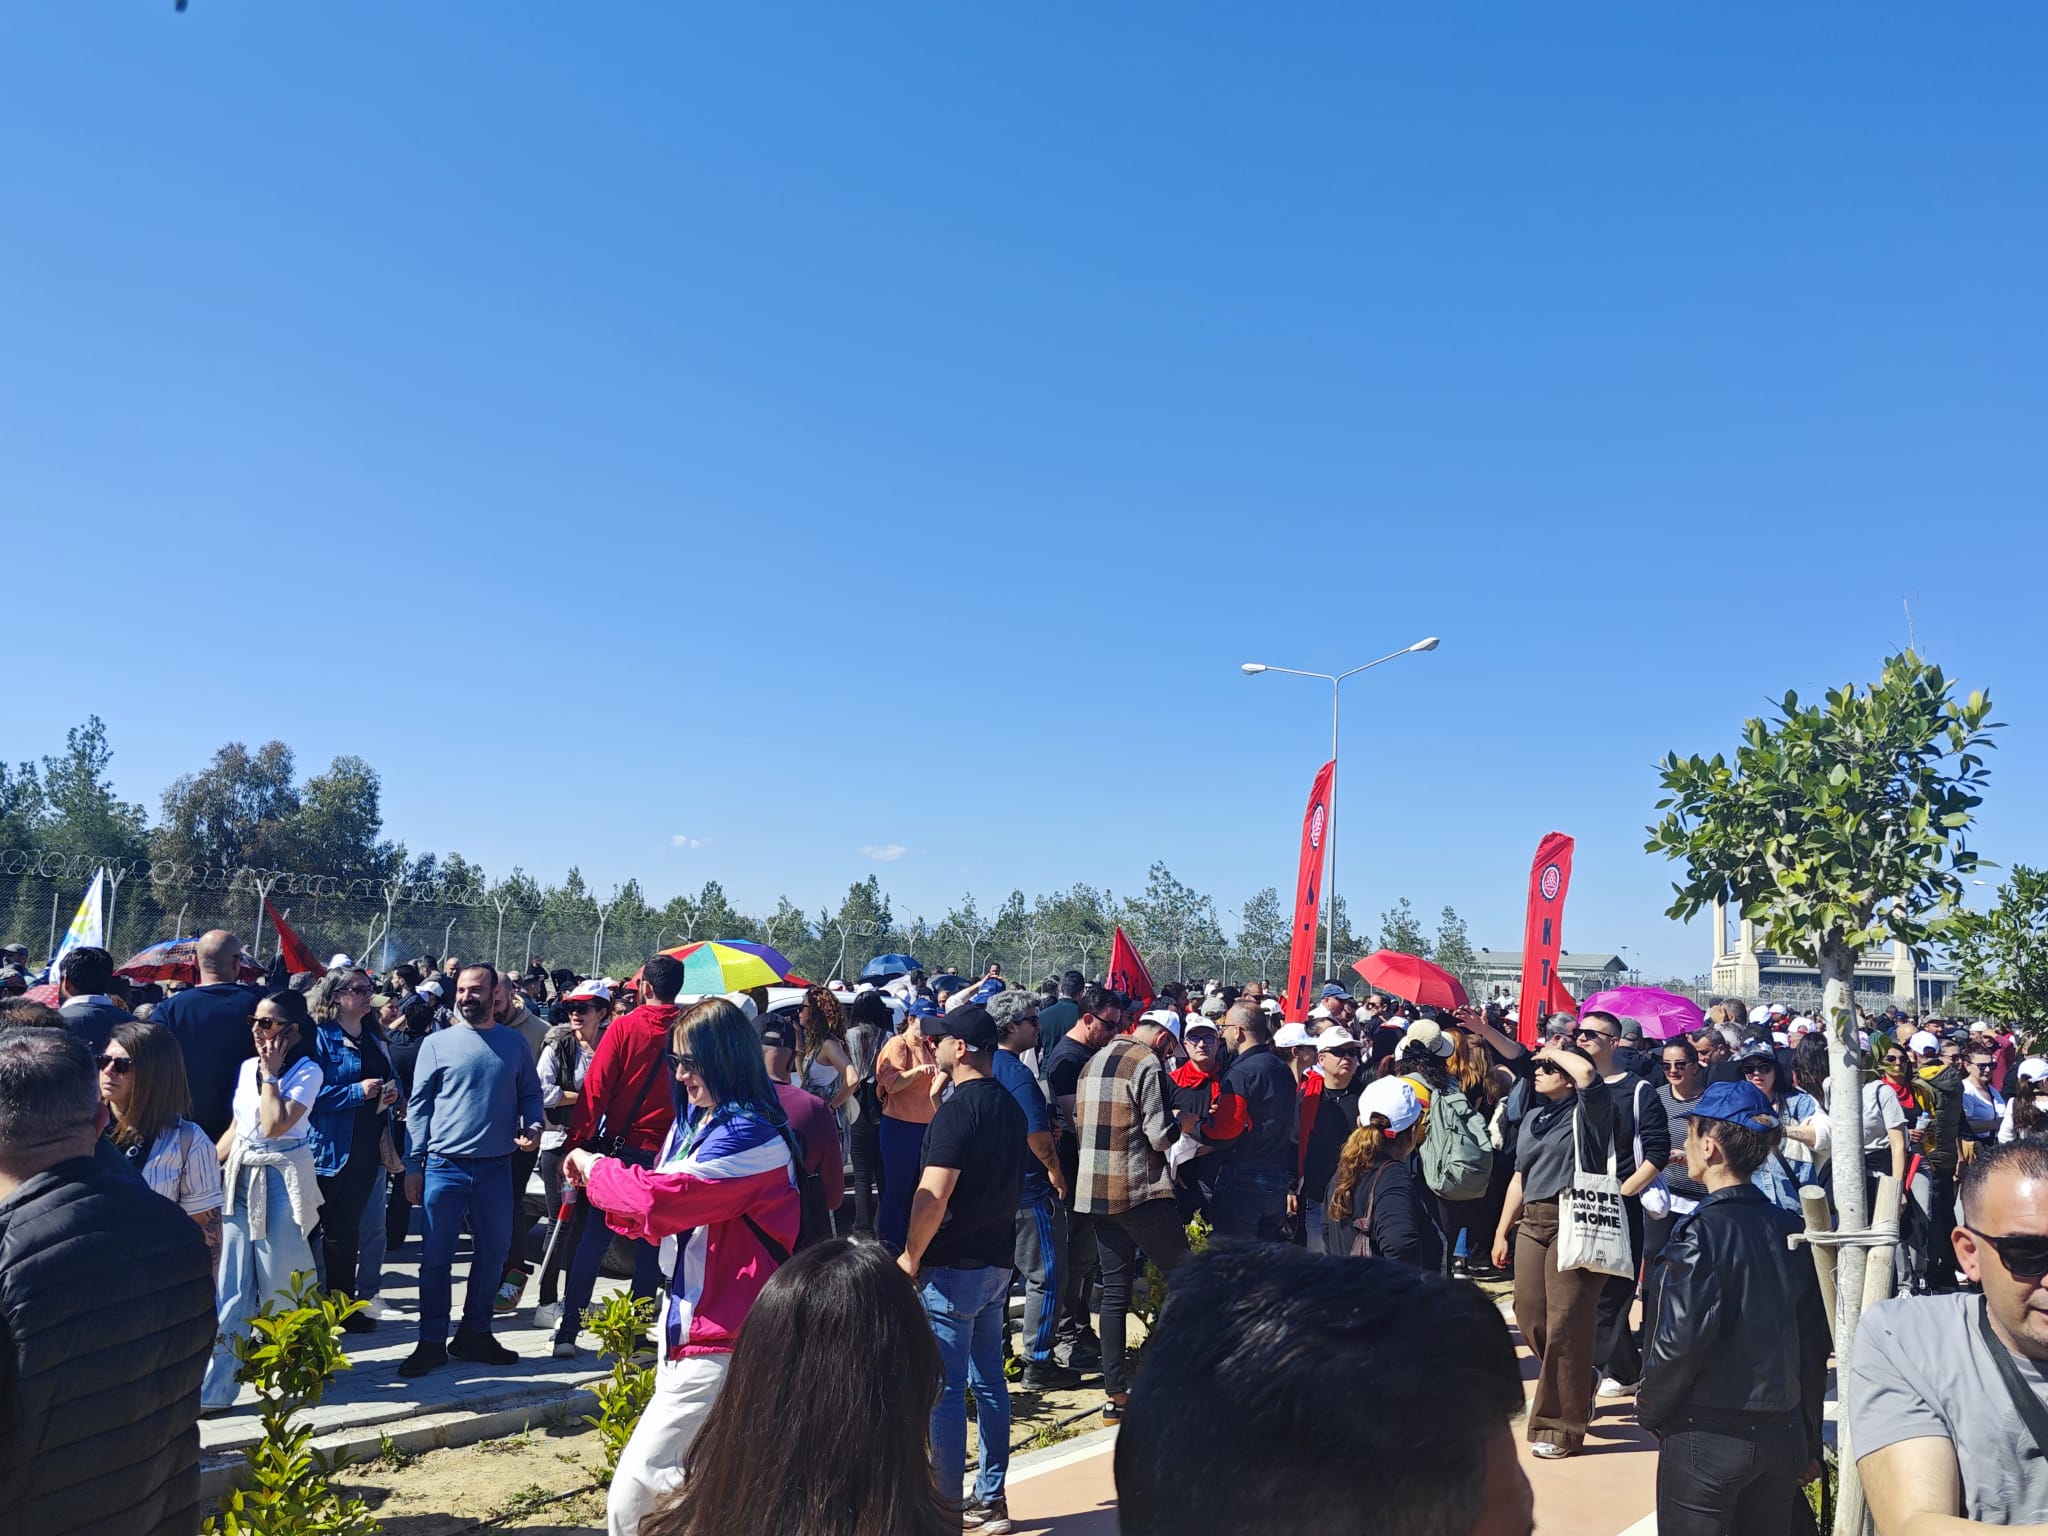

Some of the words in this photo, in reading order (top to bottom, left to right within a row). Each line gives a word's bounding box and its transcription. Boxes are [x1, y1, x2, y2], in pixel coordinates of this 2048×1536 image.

[1572, 1188, 1619, 1206] HOPE
[1573, 1203, 1596, 1211] AWAY
[1598, 1205, 1619, 1214] FROM
[1574, 1211, 1621, 1229] HOME
